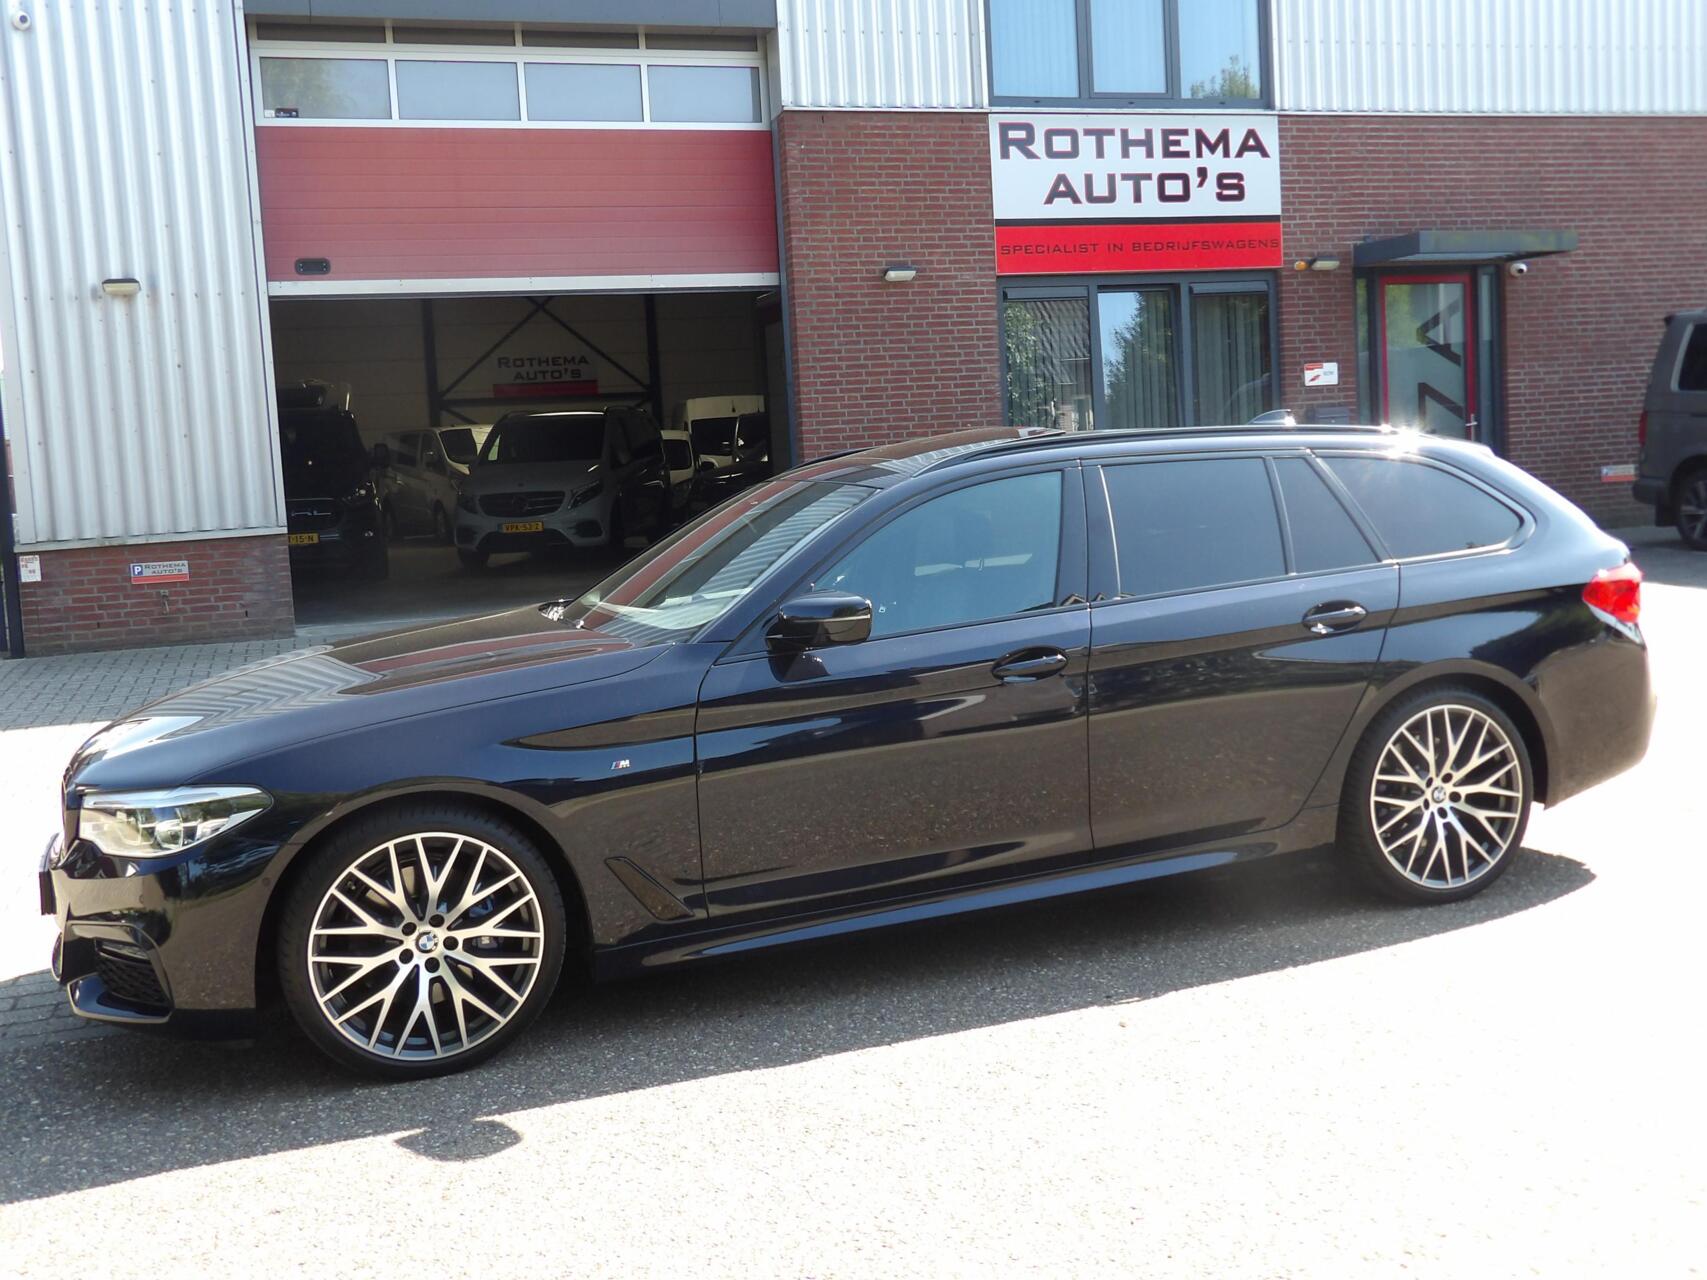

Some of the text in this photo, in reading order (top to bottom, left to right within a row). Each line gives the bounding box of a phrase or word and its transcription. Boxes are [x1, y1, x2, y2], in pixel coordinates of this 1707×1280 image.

[998, 121, 1271, 160] ROTHEMA
[1043, 166, 1246, 205] AUTO'S
[1000, 239, 1279, 256] SPECIALIST IN BEDRIJFSWAGENS
[497, 354, 590, 369] ROTHEMA
[513, 367, 582, 382] AUTO'S
[144, 562, 187, 570] ROTHEMA
